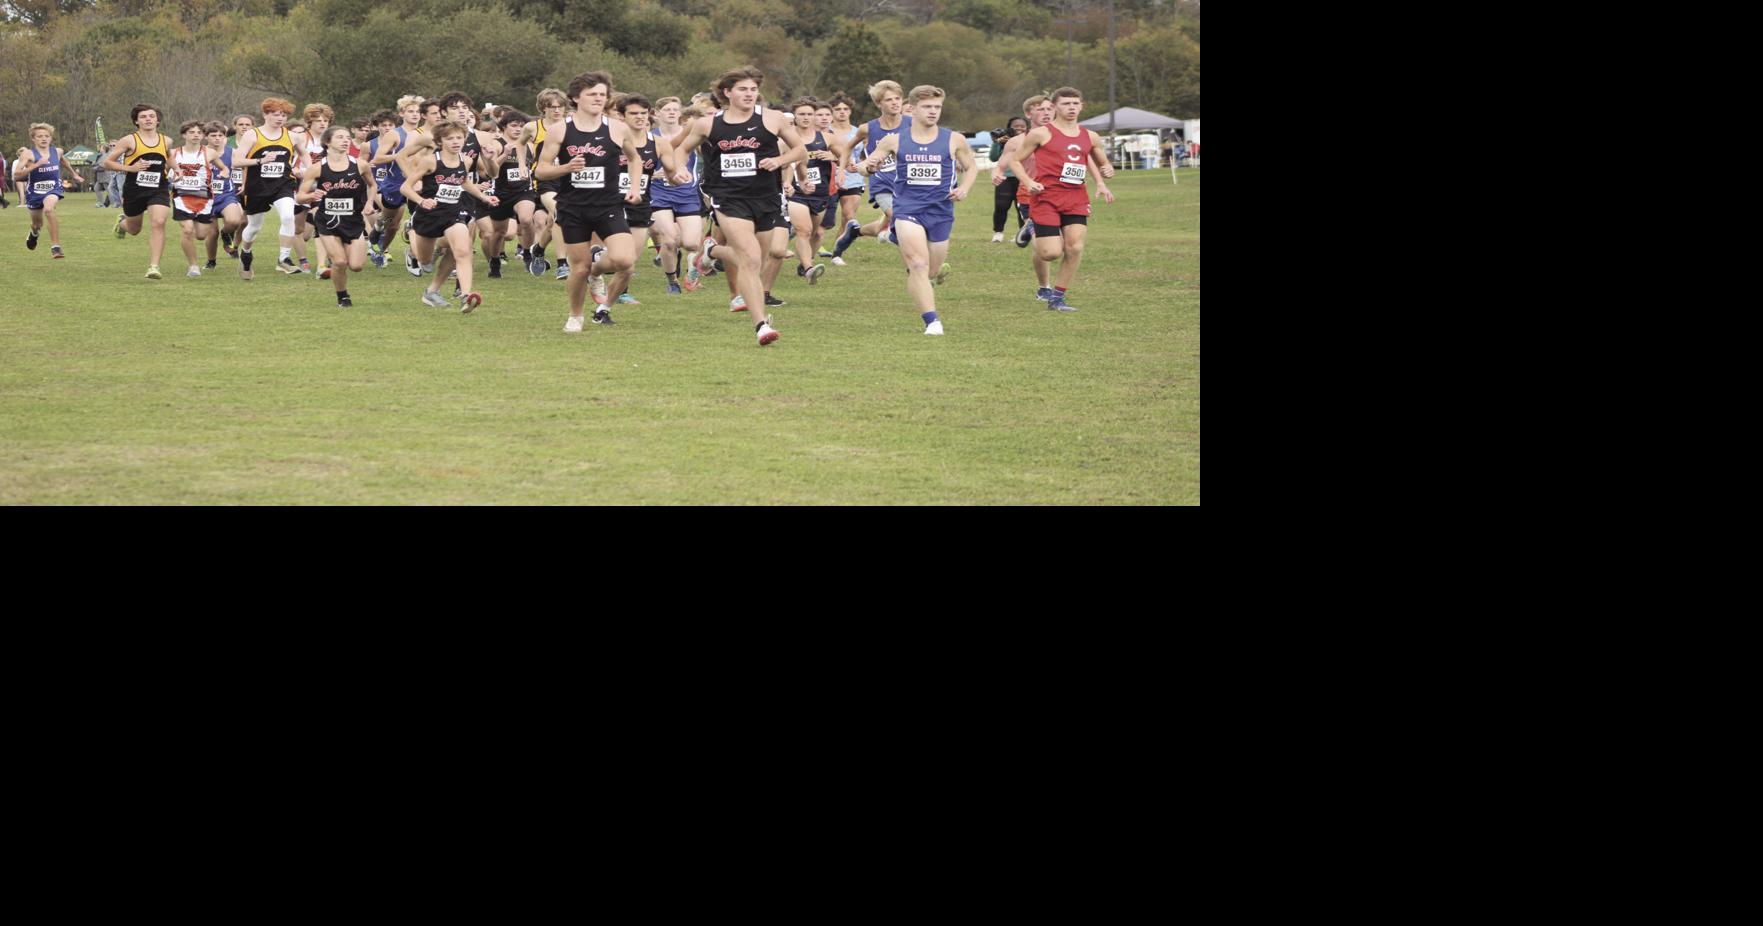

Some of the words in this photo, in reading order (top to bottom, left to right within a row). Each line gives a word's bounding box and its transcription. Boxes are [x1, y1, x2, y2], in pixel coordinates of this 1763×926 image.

[718, 136, 760, 151] Rebels
[567, 143, 605, 157] Rebels
[905, 154, 941, 162] CLEVELAND
[724, 158, 752, 169] 3456
[38, 165, 59, 173] CLEVELAND
[910, 168, 938, 177] 3392
[140, 174, 158, 183] 3482
[575, 171, 600, 181] 3447
[322, 178, 359, 191] Rebels
[622, 177, 645, 187] 345
[328, 201, 349, 210] 3441
